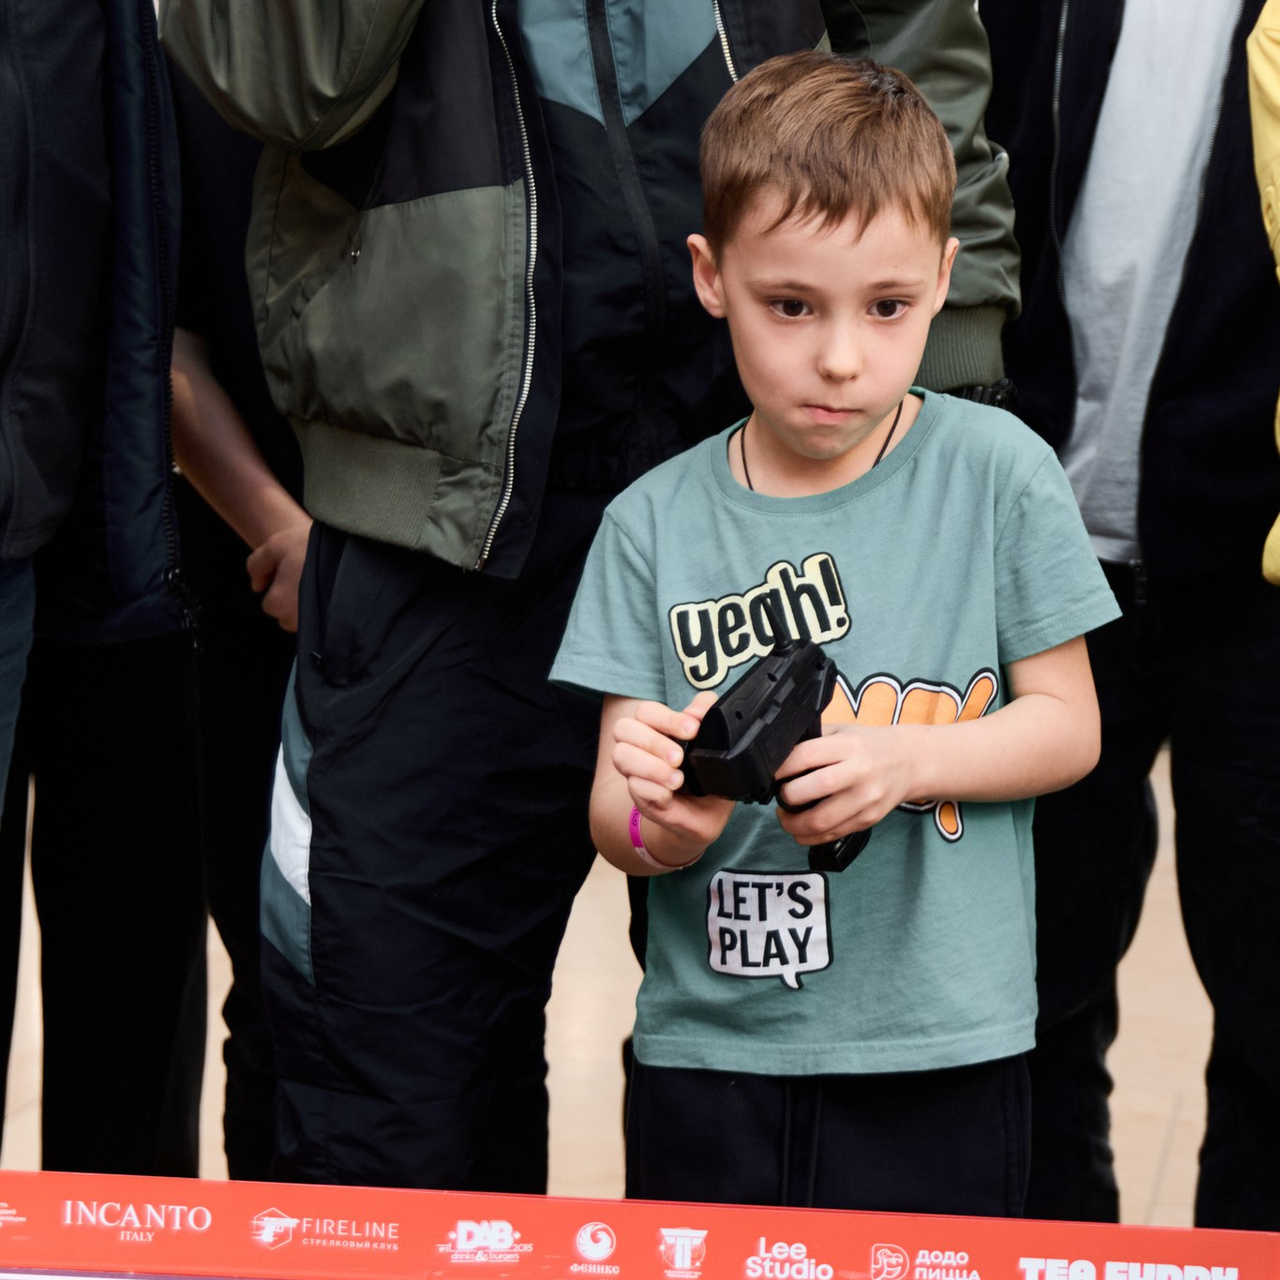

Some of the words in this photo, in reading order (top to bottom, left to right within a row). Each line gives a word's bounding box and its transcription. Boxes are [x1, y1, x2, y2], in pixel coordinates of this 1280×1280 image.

[677, 555, 848, 683] yeah!
[716, 881, 814, 921] LET'S
[718, 926, 813, 969] PLAY
[63, 1200, 212, 1231] INCANTO
[302, 1217, 399, 1239] FIRELINE
[120, 1230, 155, 1242] ITALY
[302, 1238, 371, 1249] СТРЕЛКОВЫЙ
[372, 1242, 399, 1251] КЛУБ
[456, 1220, 515, 1250] DAB
[758, 1236, 808, 1260] Lee
[914, 1249, 970, 1266] ДОДО
